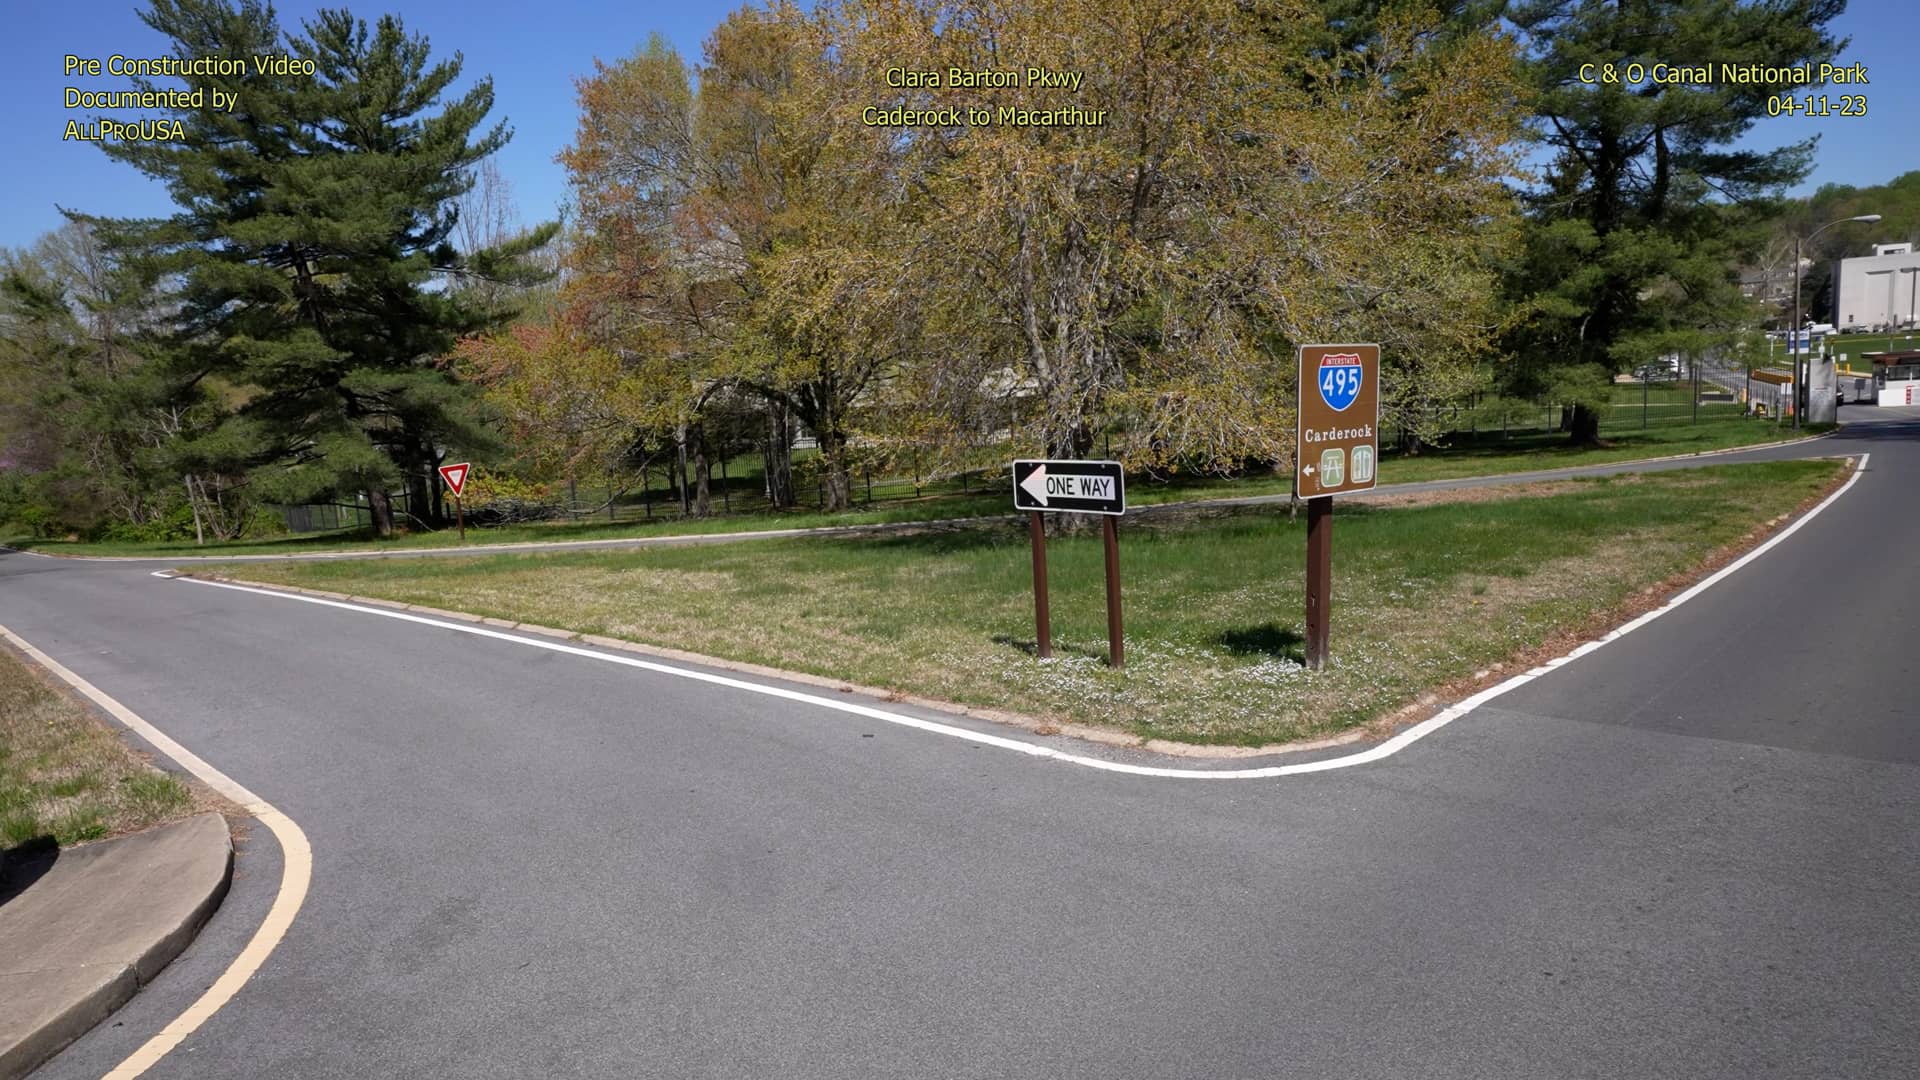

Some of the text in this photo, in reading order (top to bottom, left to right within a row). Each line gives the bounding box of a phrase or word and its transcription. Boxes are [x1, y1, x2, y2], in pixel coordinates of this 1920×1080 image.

[1326, 357, 1356, 365] INTERSTATE
[1323, 369, 1358, 396] 495
[1305, 424, 1372, 442] Carderock
[1047, 477, 1110, 496] ONE WAY
